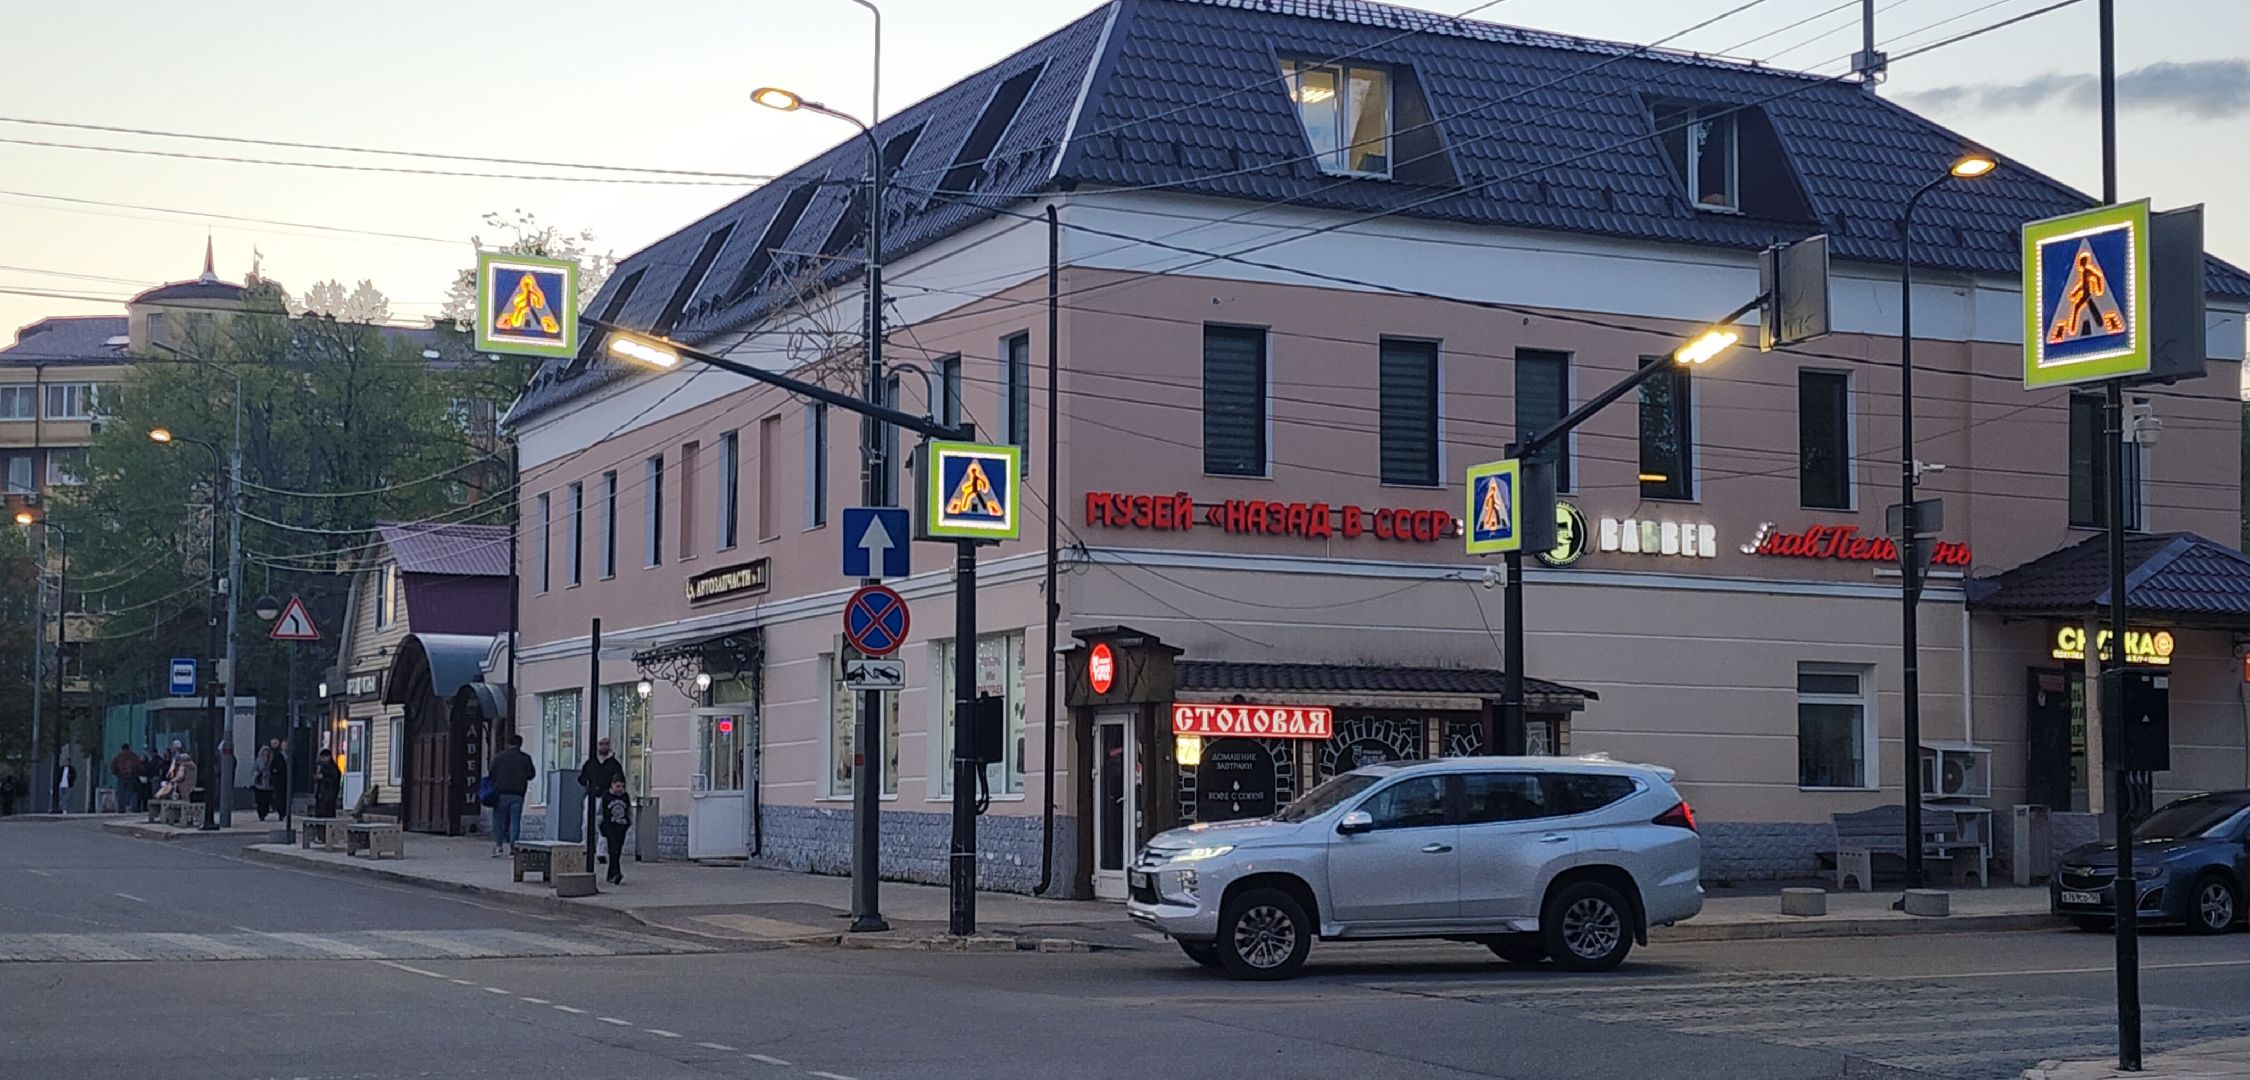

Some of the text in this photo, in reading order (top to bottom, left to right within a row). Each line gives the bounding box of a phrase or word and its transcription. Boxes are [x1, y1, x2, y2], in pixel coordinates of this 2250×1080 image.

[1086, 491, 1192, 531] МУЗЕЙ
[1206, 499, 1332, 539] «НАЗАД
[1342, 505, 1362, 538] В
[1600, 518, 1716, 558] BARBER
[1175, 707, 1326, 734] СТОЛОВАЯ
[1211, 753, 1257, 761] ДОМАШНИЕ
[1216, 762, 1253, 770] ЗАВТРАКИ
